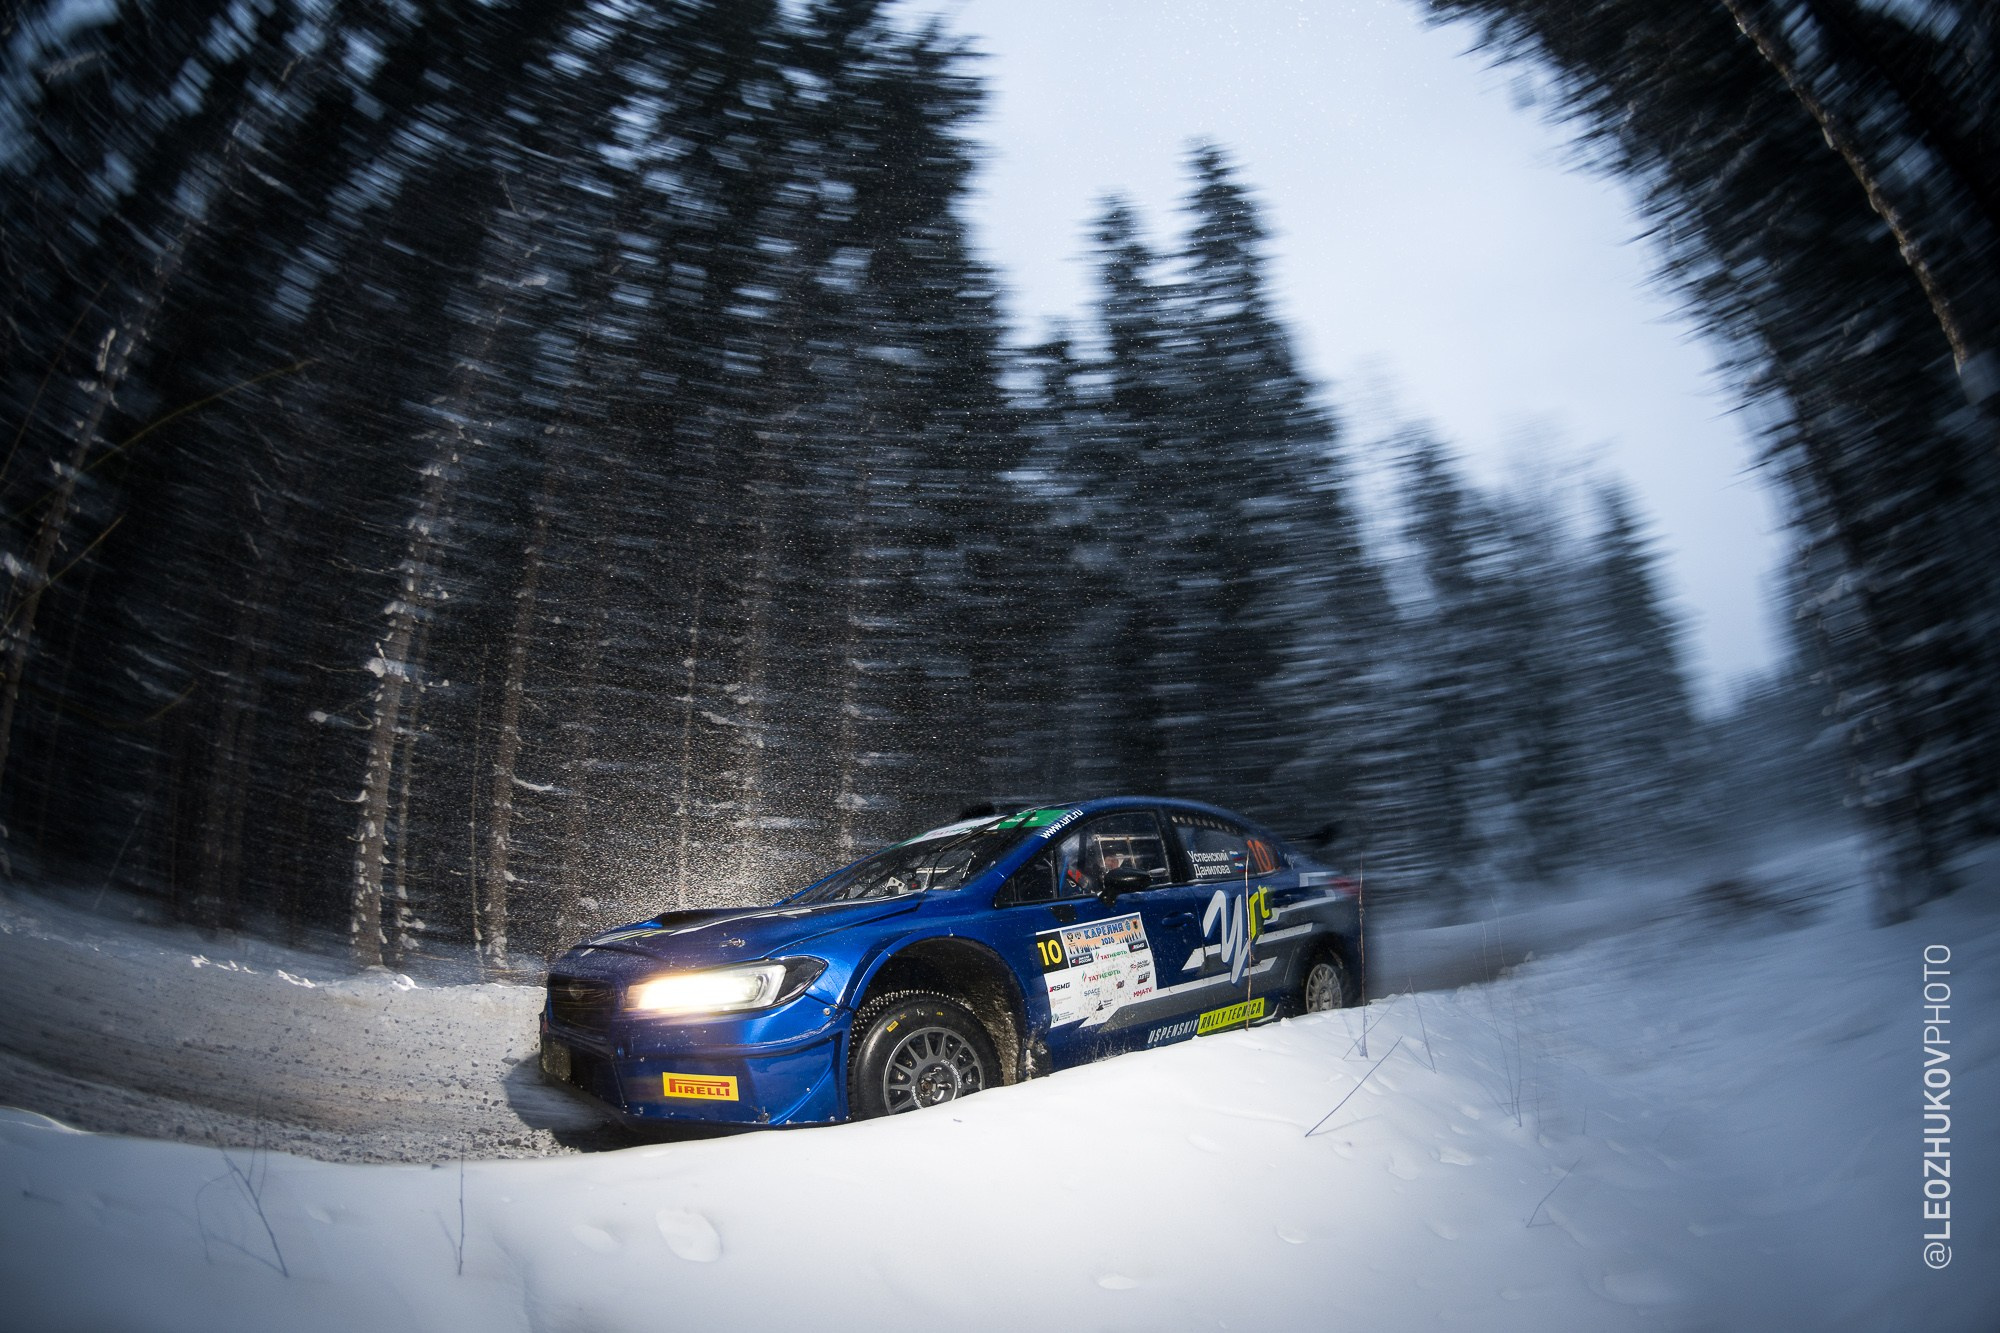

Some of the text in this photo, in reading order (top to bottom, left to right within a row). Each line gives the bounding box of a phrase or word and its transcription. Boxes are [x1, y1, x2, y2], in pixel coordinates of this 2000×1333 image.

[1040, 809, 1083, 839] www.urt.ru
[1187, 850, 1229, 863] Успенский
[1247, 839, 1276, 873] 10
[1193, 863, 1231, 878] Данилова
[1084, 922, 1125, 939] КАРЕЛИЯ
[1037, 939, 1063, 966] 10
[1101, 949, 1128, 960] ТАТНЕФТЬ
[1088, 970, 1121, 981] ТАТНЕФТЬ
[1051, 982, 1071, 993] RSMG
[1200, 1012, 1227, 1029] RALLY
[1147, 1019, 1199, 1043] USPENSKIY
[669, 1078, 731, 1097] PIRELLI
